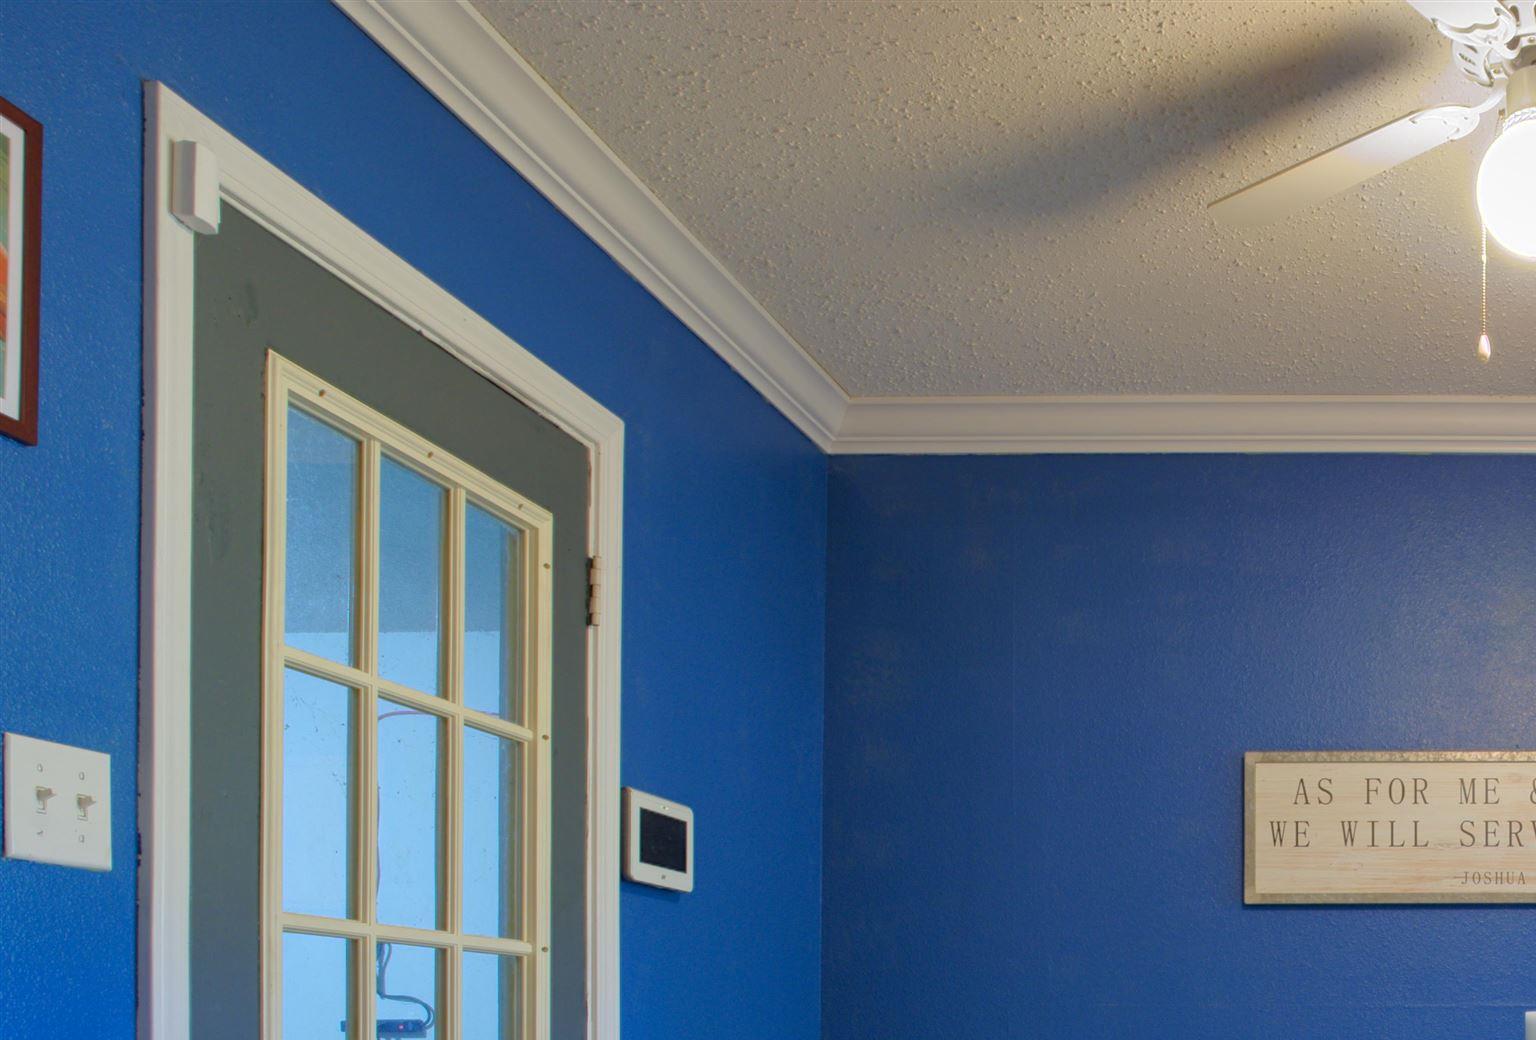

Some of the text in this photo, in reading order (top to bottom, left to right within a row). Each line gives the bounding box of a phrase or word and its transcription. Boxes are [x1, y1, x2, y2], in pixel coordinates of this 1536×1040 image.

[1292, 777, 1334, 806] AS
[1364, 777, 1430, 806] FOR
[1458, 777, 1501, 806] ME
[1269, 820, 1311, 848] WE
[1340, 820, 1430, 848] WILL
[1460, 871, 1527, 886] JOSHUA
